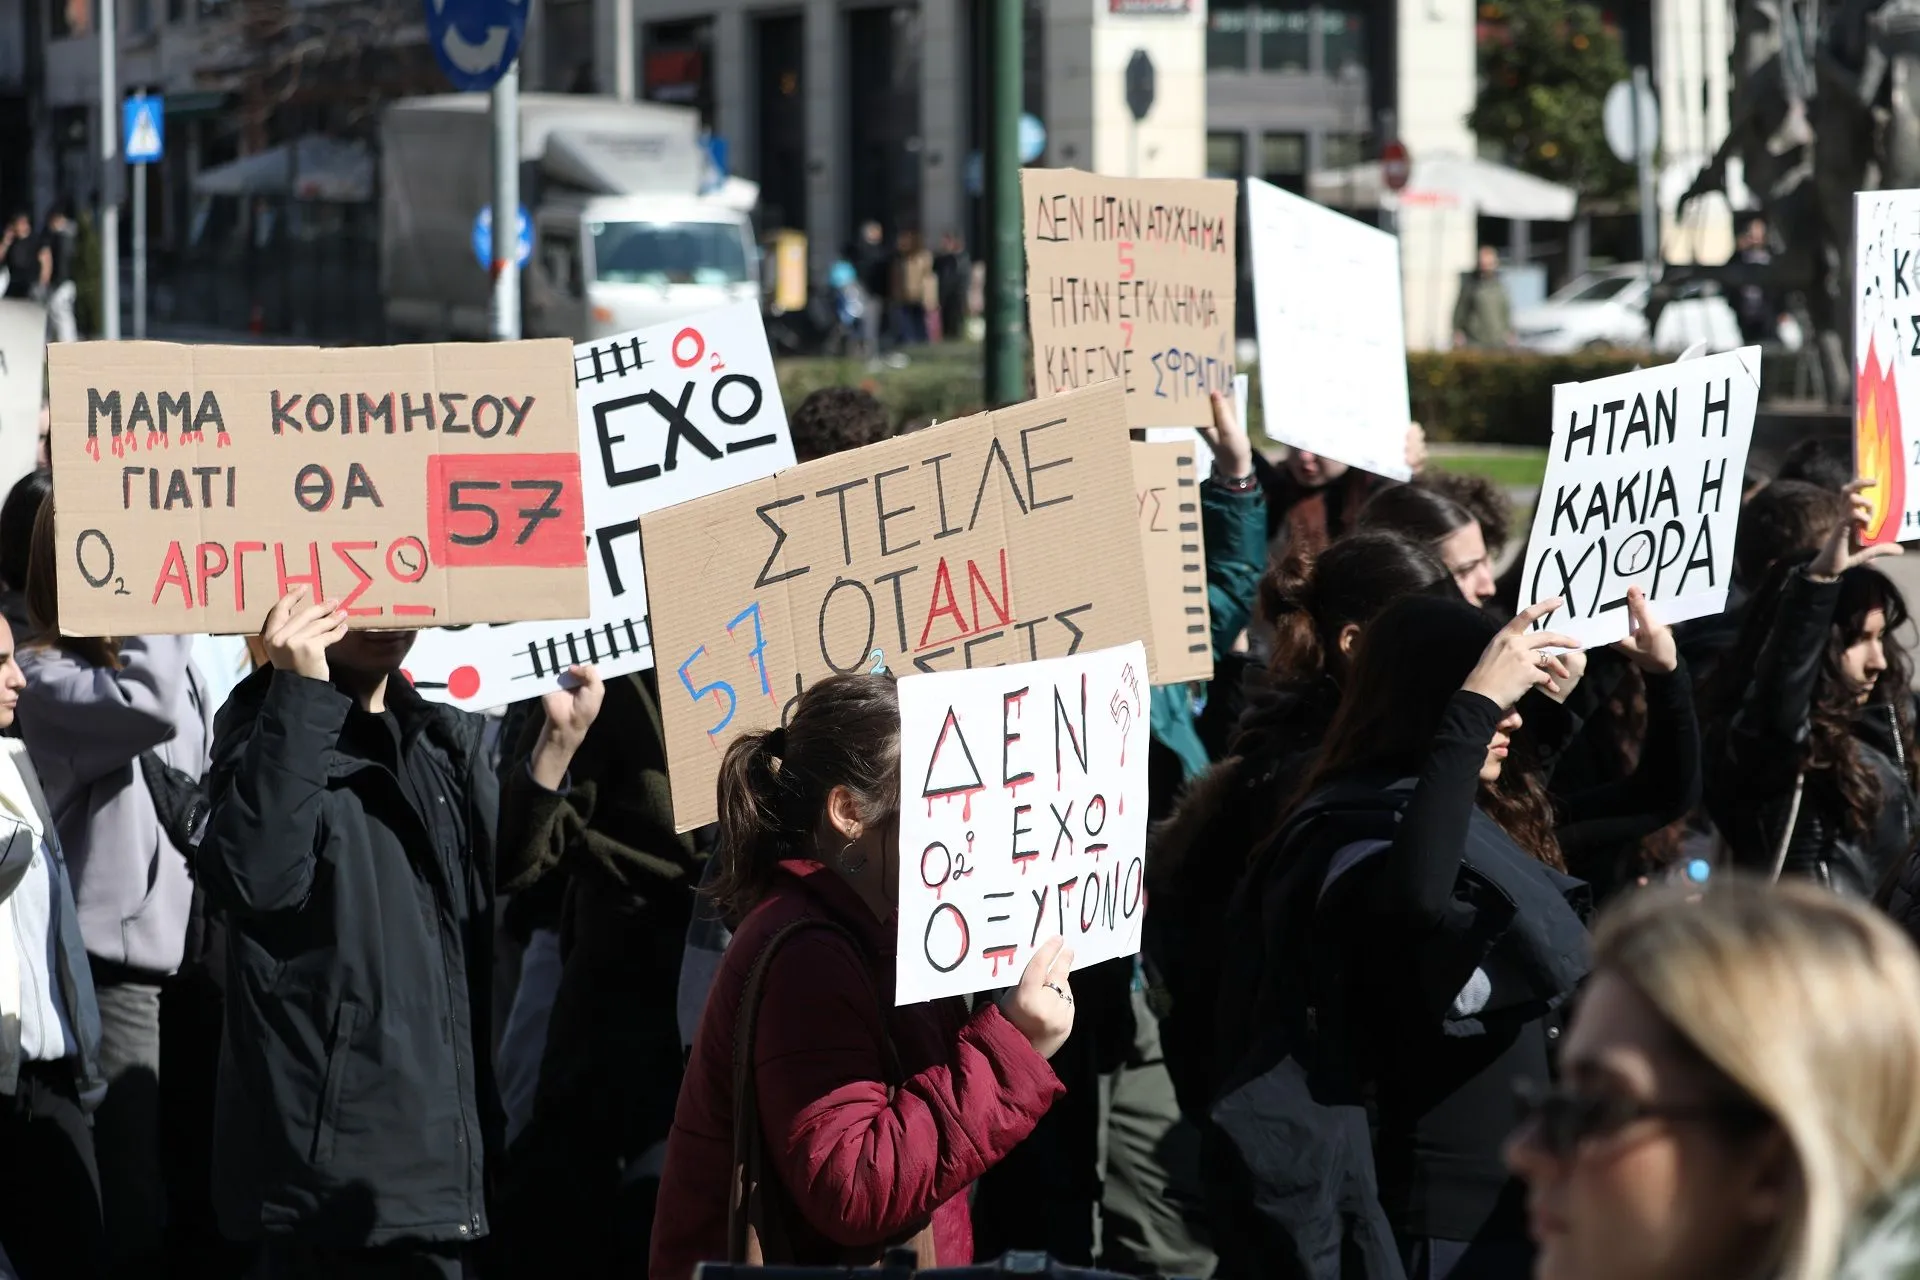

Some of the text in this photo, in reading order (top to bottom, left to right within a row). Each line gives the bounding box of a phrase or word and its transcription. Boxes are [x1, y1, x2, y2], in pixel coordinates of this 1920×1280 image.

[1037, 194, 1226, 254] ΔΕΝ ΗΤΑΝ ΑΤΥΧΗΜΑ
[1118, 242, 1135, 279] 5
[1050, 276, 1110, 328] ΗΤΑΝ
[86, 387, 536, 448] ΜΑΜΑ ΚΟΙΜΗΣΟΥ
[1564, 377, 1731, 463] ΗΤΑΝ Η
[122, 462, 385, 512] ΓΙΑΤΙ ΘΑ
[448, 479, 564, 548] 57
[754, 417, 1074, 590] ΣΤΕΙΛΕ
[1550, 457, 1727, 537] ΚΑΚΙΑ Η
[676, 600, 778, 738] 57
[921, 672, 1088, 800] ΔΕΝ
[923, 857, 1142, 974] ΟΞΥΓΟΝΟ
